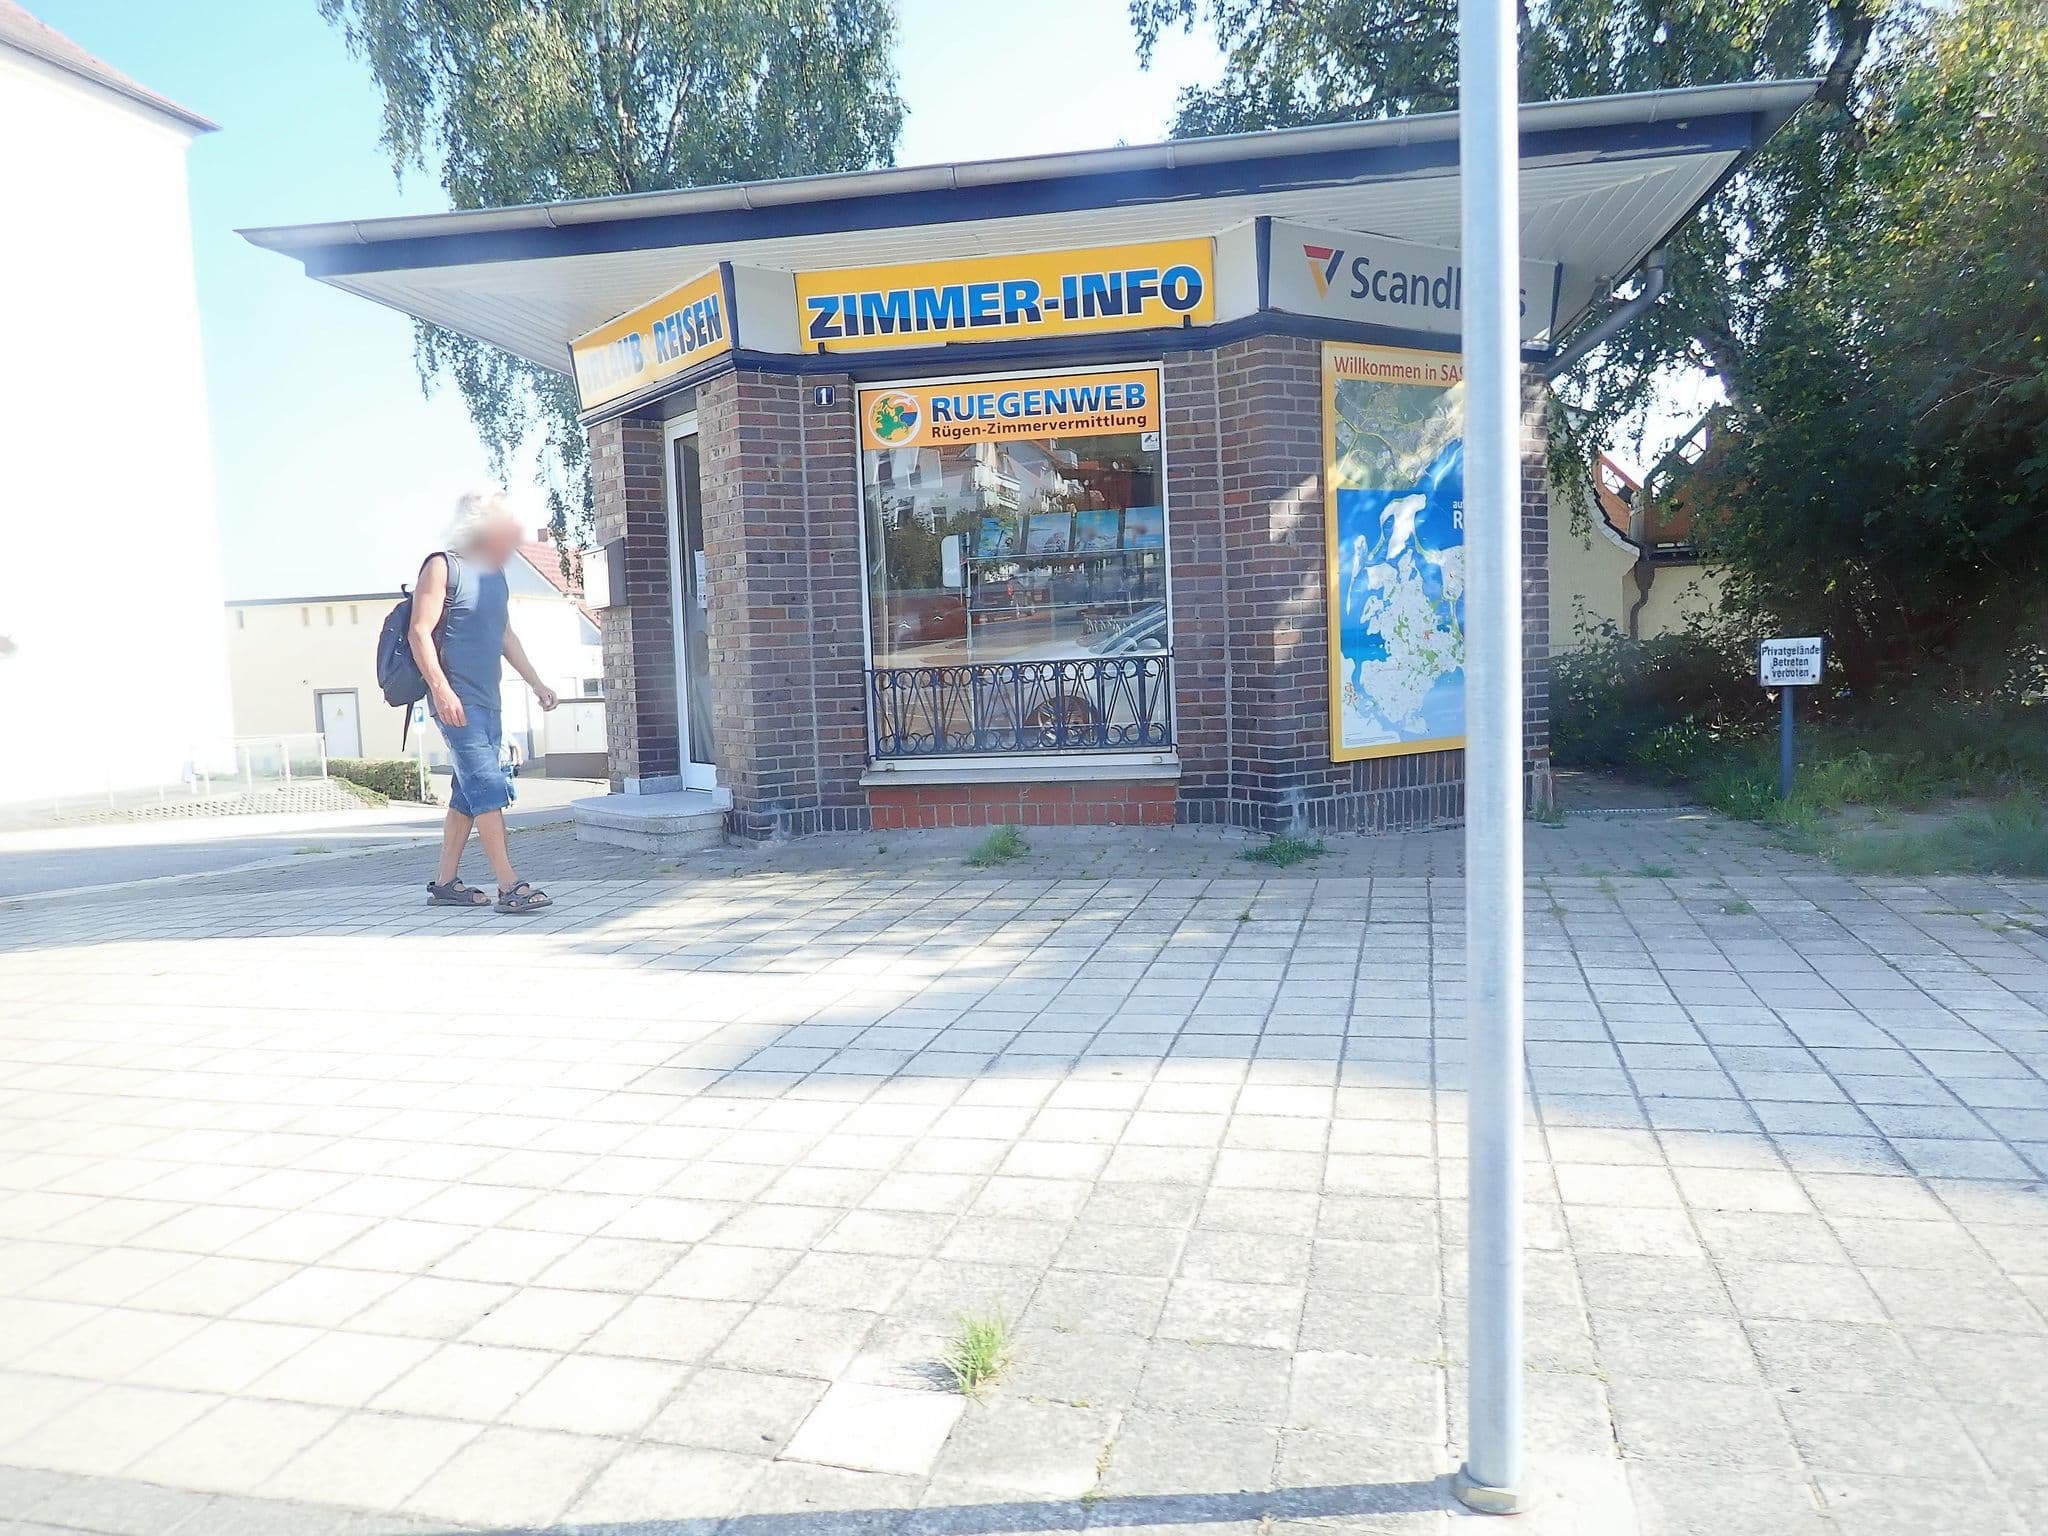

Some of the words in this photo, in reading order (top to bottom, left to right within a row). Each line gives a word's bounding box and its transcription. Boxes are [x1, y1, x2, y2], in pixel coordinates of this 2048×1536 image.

[1350, 257, 1526, 318] Scandl
[807, 265, 1203, 339] ZIMMER-INFO
[652, 293, 724, 365] REISEN
[1334, 355, 1421, 379] Willkommen
[1425, 363, 1437, 380] in
[931, 382, 1147, 423] RUEGENWEB
[931, 413, 1147, 440] Rügen-Zimmervermittlung
[1761, 645, 1820, 657] Privatgelände
[1773, 657, 1809, 667] Betreten
[1772, 669, 1809, 678] verboten
